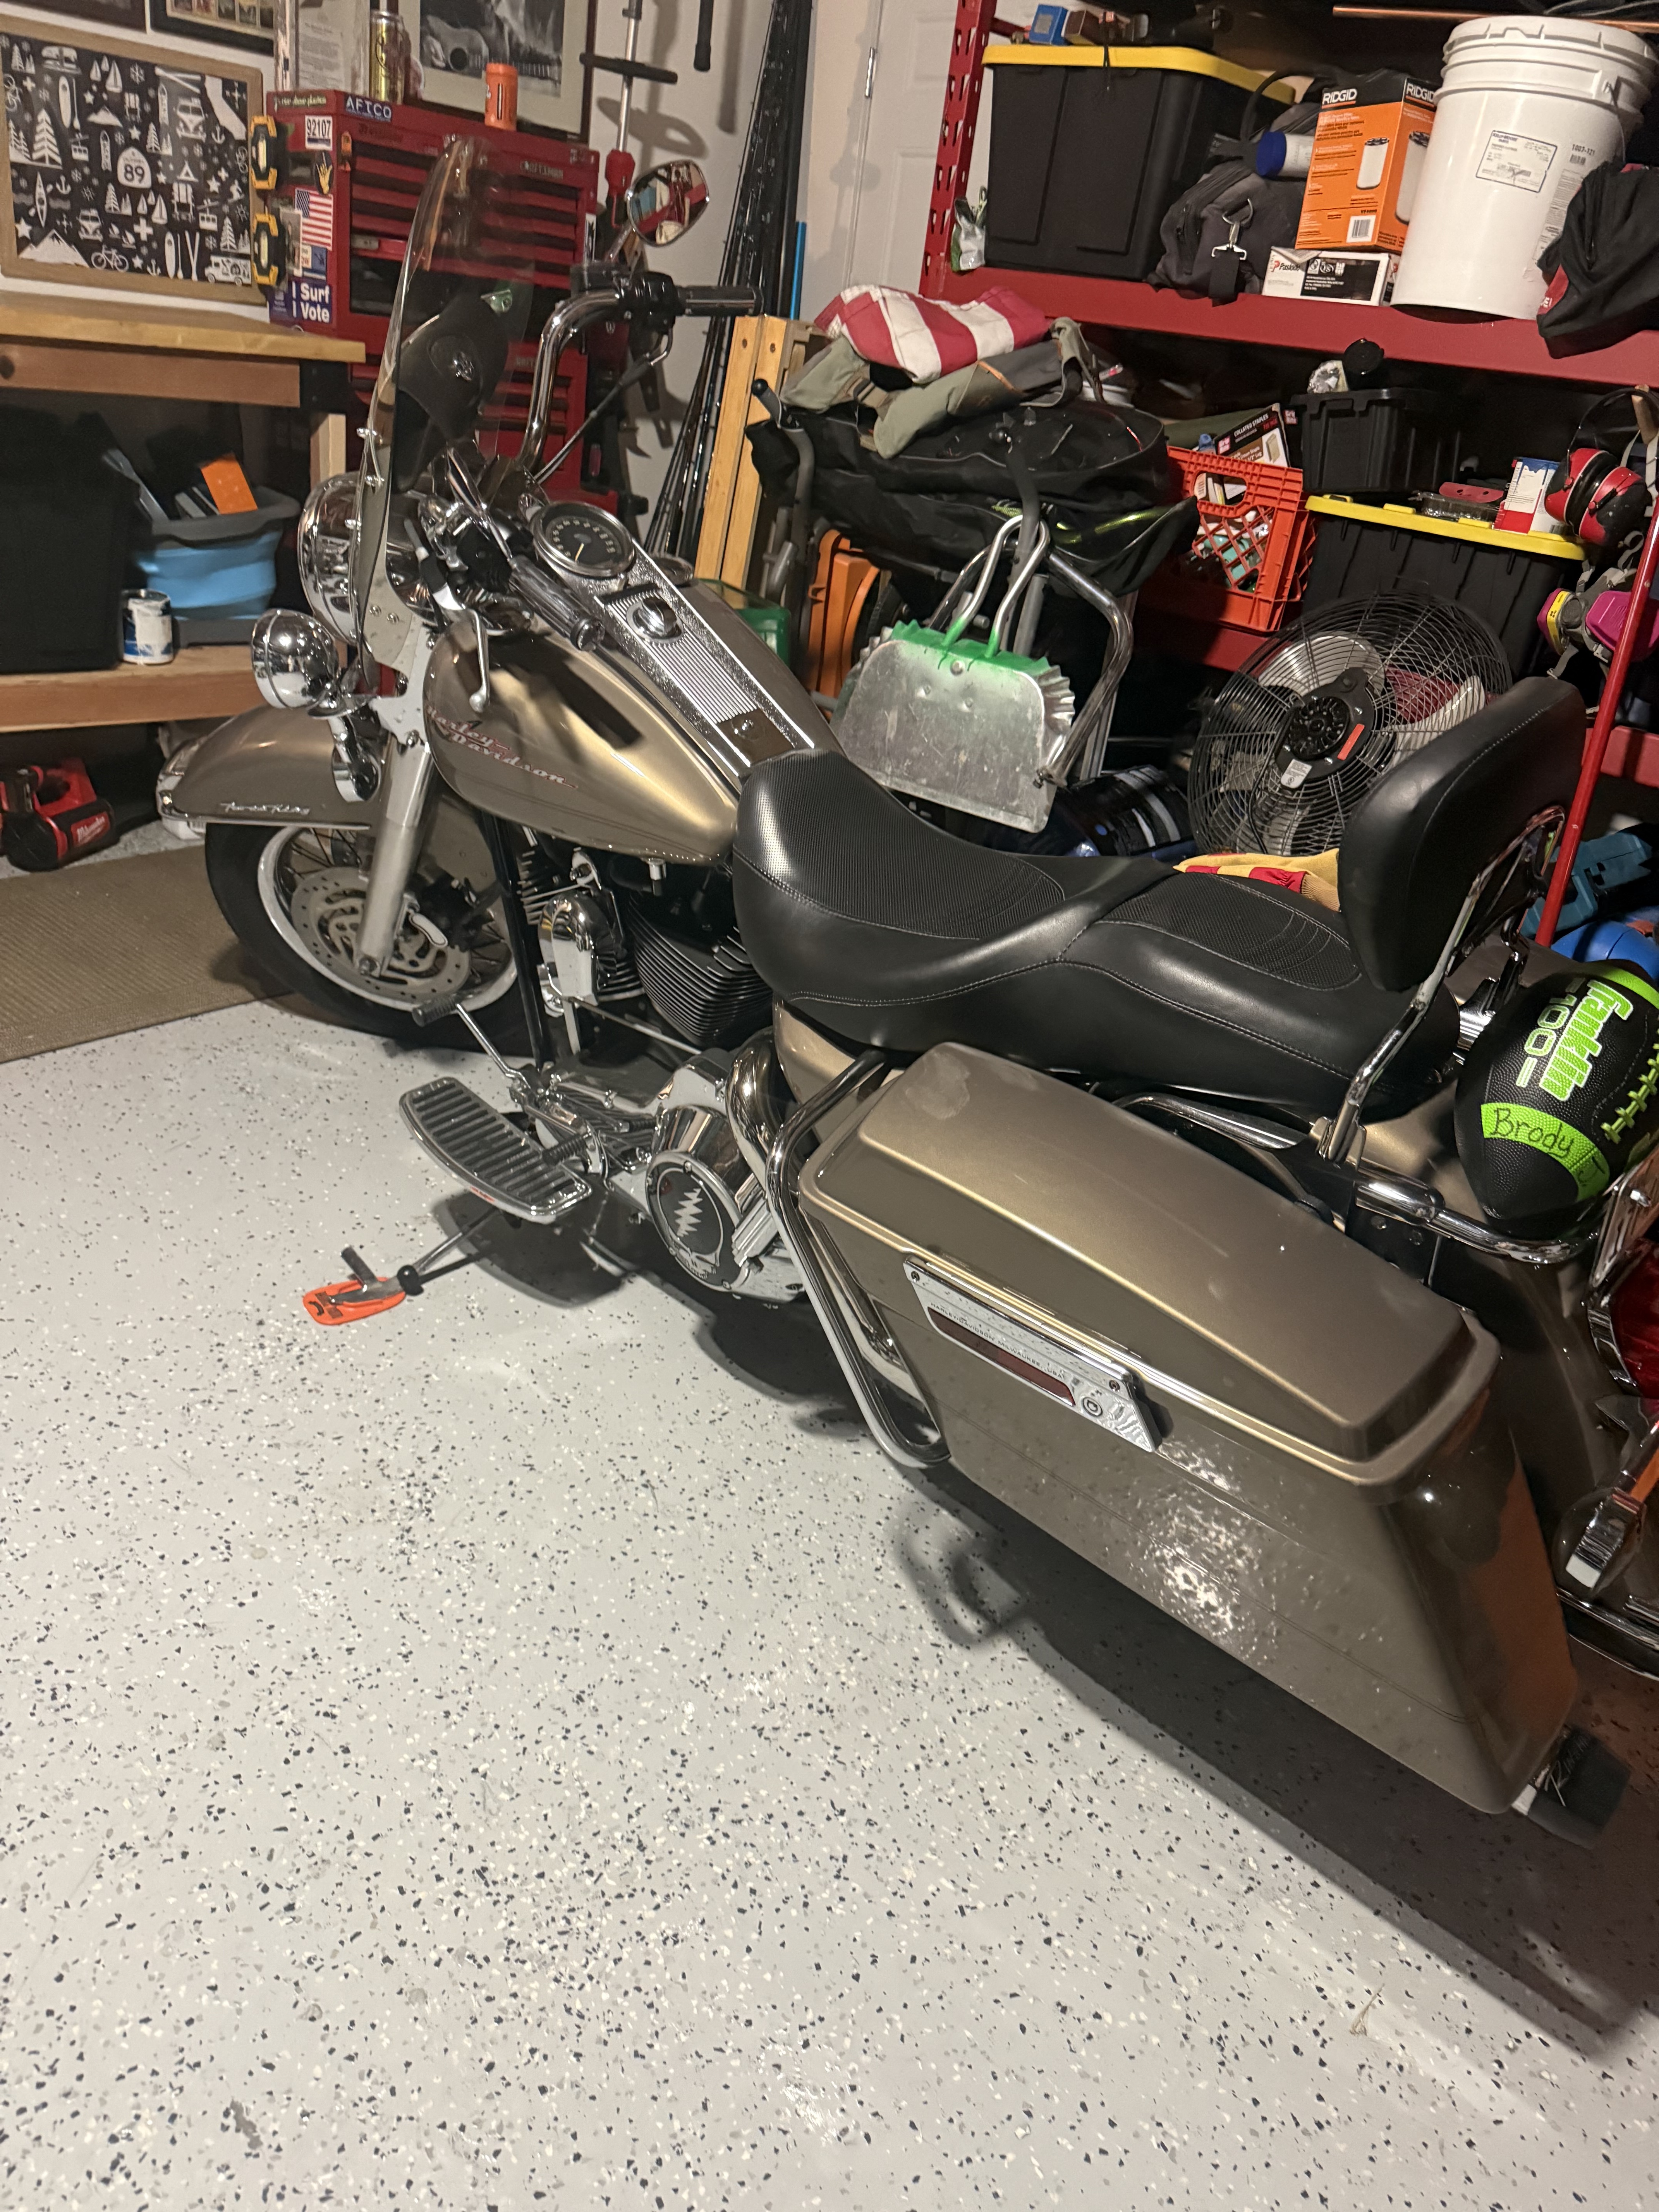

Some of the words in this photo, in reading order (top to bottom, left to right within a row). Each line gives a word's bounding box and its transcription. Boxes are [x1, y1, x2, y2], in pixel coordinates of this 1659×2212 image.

[346, 96, 392, 118] AFTCO
[1322, 88, 1358, 105] RIDGID
[307, 118, 331, 137] 92107
[124, 163, 145, 184] 89
[292, 281, 296, 299] I
[300, 282, 330, 304] Surf
[292, 300, 297, 318] I
[300, 301, 330, 323] Vote
[1234, 422, 1252, 438] COLLATED
[1252, 413, 1269, 427] STAPLES
[451, 733, 579, 788] Davidson
[1491, 1108, 1575, 1158] Brody
